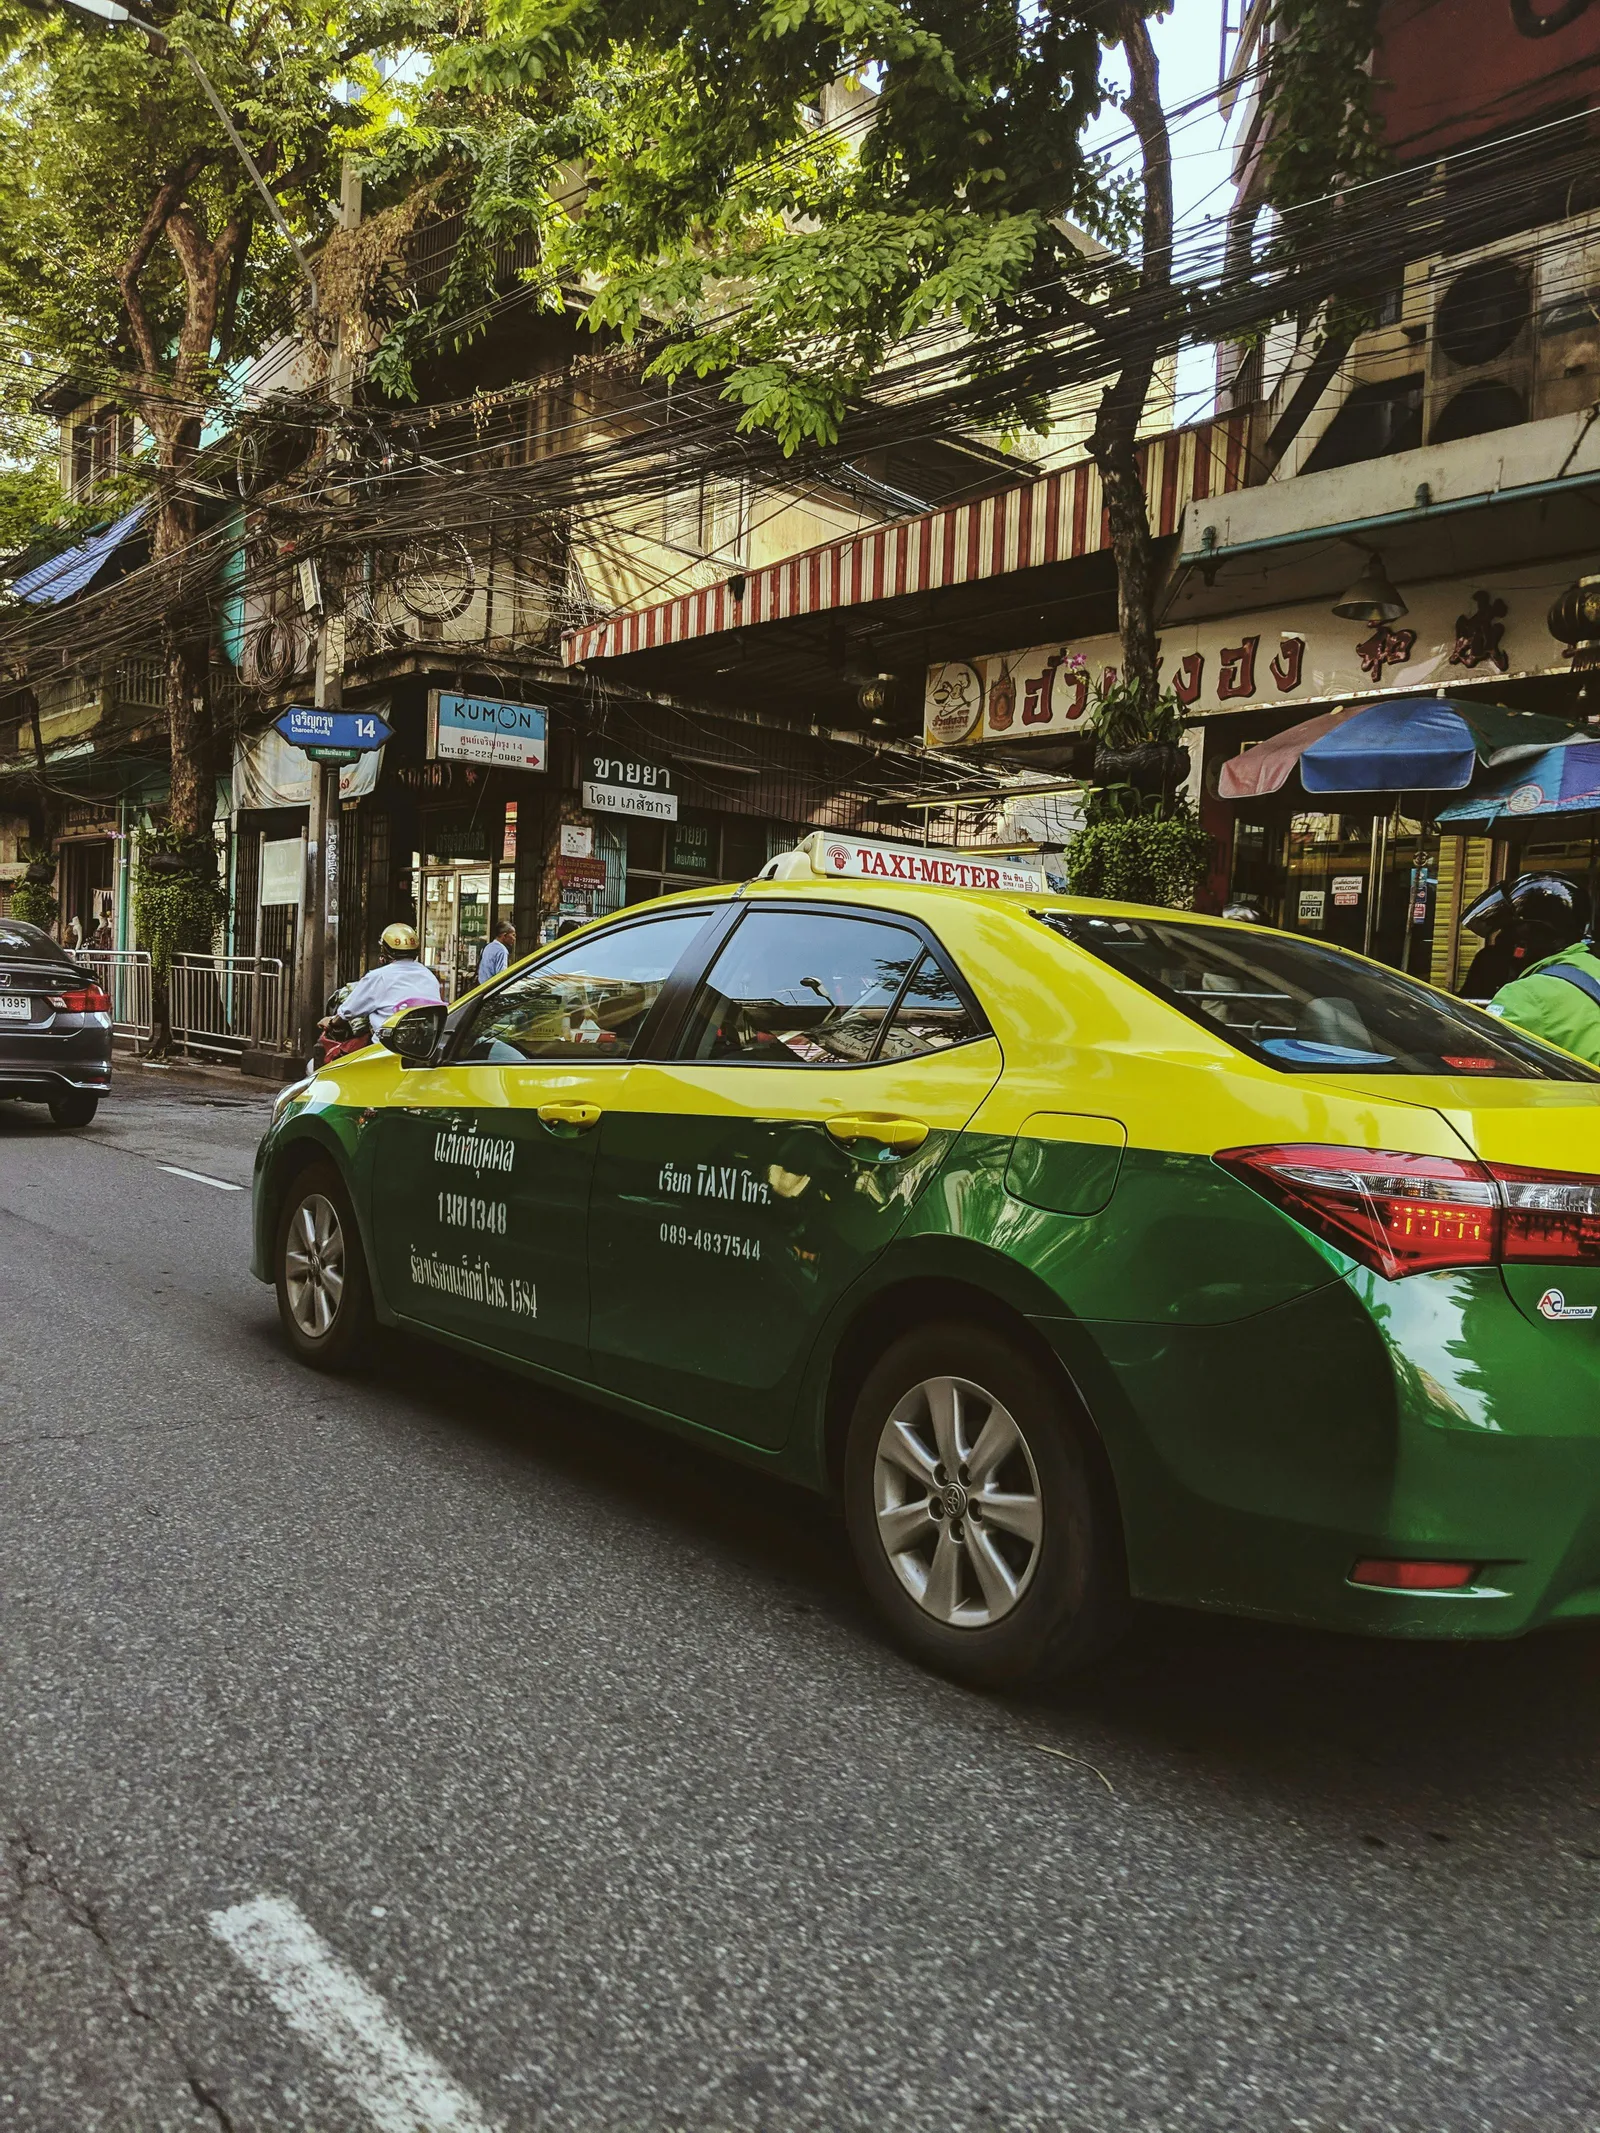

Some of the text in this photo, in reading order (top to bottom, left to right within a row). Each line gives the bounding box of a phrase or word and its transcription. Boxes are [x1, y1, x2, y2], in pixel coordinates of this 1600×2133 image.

[291, 711, 376, 738] เจริญกรุง 14
[454, 702, 532, 729] KUMON
[291, 726, 331, 736] Charoen Krung
[593, 757, 671, 789] ขายยา
[589, 785, 672, 815] โดย เภสัชกร
[856, 849, 1001, 890] TAXI-METER
[464, 904, 484, 918] ขาย
[1300, 906, 1321, 917] OPEN
[467, 920, 480, 933] ยา
[1, 997, 26, 1008] 1395
[434, 1119, 515, 1179] แท็กซี่บุคคล
[659, 1162, 771, 1205] เรียก TAXI โทร.
[470, 1197, 507, 1235] 1348
[660, 1222, 760, 1261] 089-4837544
[509, 1278, 538, 1319] 1584
